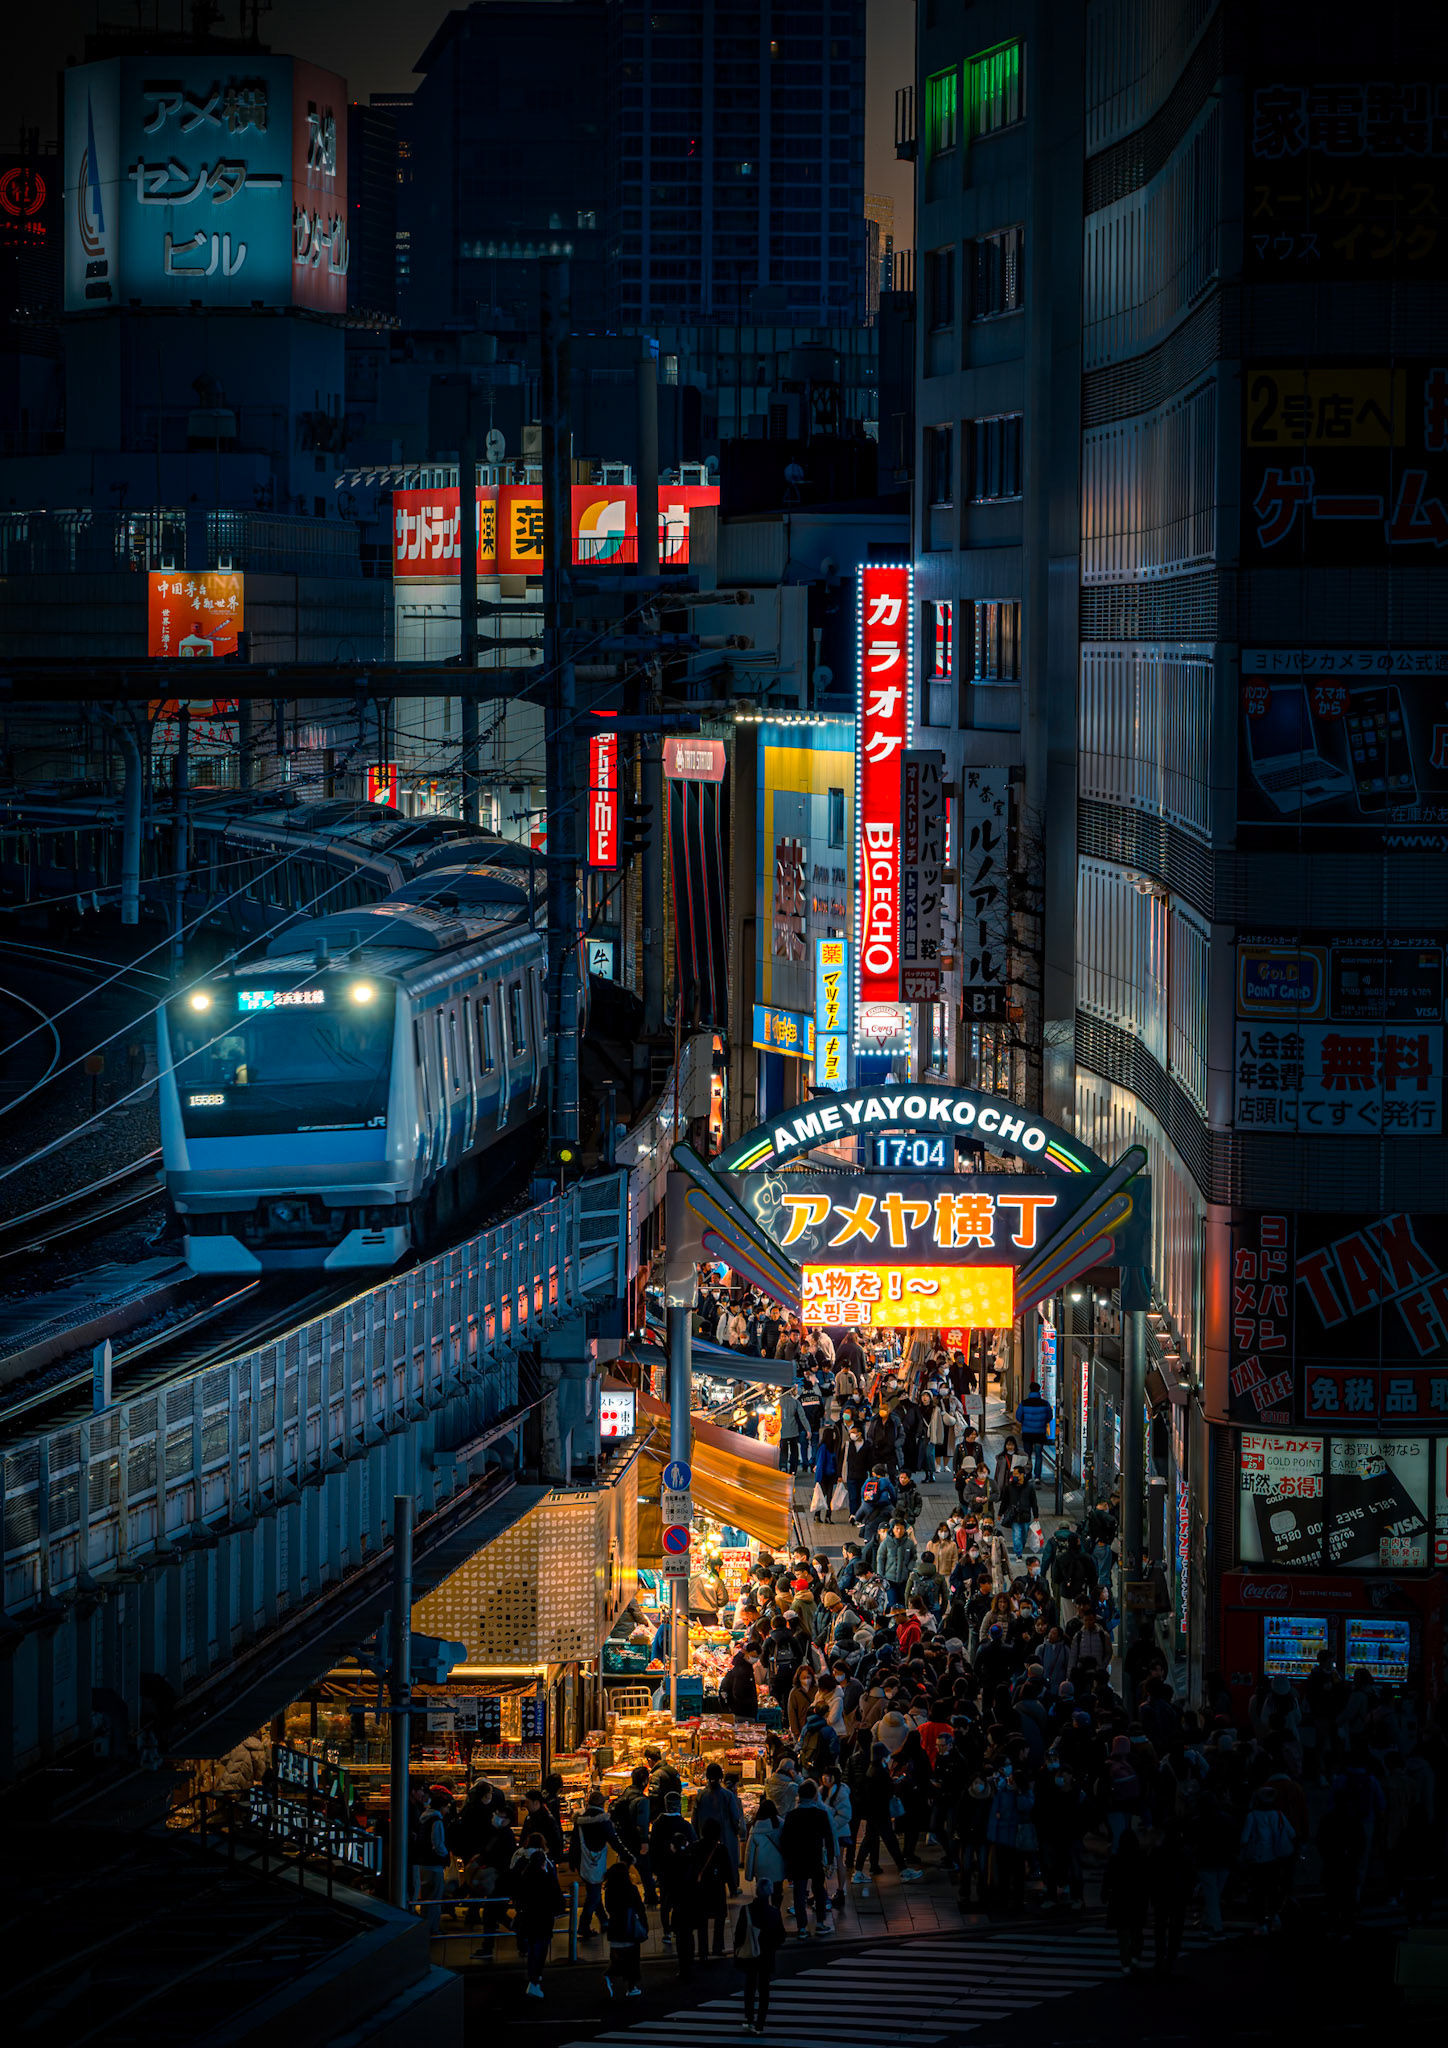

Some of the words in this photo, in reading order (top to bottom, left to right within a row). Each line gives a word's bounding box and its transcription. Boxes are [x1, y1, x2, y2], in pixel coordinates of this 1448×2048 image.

[144, 88, 267, 134] アメ横
[128, 160, 283, 205] センター
[1251, 180, 1440, 218] スーツケース
[164, 231, 247, 276] ビル
[1250, 229, 1321, 261] マウス
[1331, 223, 1438, 262] インク
[1251, 376, 1394, 441] 2号店へ
[1252, 465, 1448, 549] ゲーム
[482, 505, 495, 554] 薬
[865, 594, 902, 763] カラオケ
[1314, 686, 1347, 701] スマホ
[1247, 701, 1266, 715] から
[1318, 702, 1343, 716] から
[865, 822, 893, 881] BIG
[968, 819, 1003, 983] ルノアール
[865, 887, 893, 975] ECHO
[823, 944, 841, 964] 薬
[1257, 961, 1299, 982] GOLD
[822, 970, 842, 1080] マツモトキヨシ
[972, 993, 997, 1014] B1
[1415, 1008, 1439, 1017] VISA
[1240, 1031, 1305, 1060] 入会金
[1321, 1034, 1433, 1091] 無料
[1239, 1061, 1304, 1091] 年会費
[367, 1115, 386, 1127] JR
[774, 1096, 1047, 1154] AMEYAYOKOCHO
[1239, 1096, 1437, 1128] 店頭にてすぐ発行
[876, 1138, 946, 1167] 17:04
[779, 1192, 1058, 1249] アメヤ横丁
[1260, 1215, 1289, 1351] ヨドバシ
[1296, 1213, 1442, 1329] TAX
[803, 1301, 871, 1325] 쇼핑을!
[1234, 1247, 1258, 1350] カメラ
[1394, 1273, 1448, 1357] F
[1230, 1355, 1267, 1398] TAX
[1250, 1370, 1294, 1413] FREE
[1242, 1436, 1322, 1453] ヨドバシカメラ
[1330, 1442, 1421, 1457] でお買い物なら
[1267, 1456, 1291, 1466] GOLD
[1293, 1458, 1321, 1468] POINT
[1330, 1460, 1358, 1469] CARD
[1306, 1521, 1324, 1536] 00
[1384, 1515, 1425, 1537] VISA
